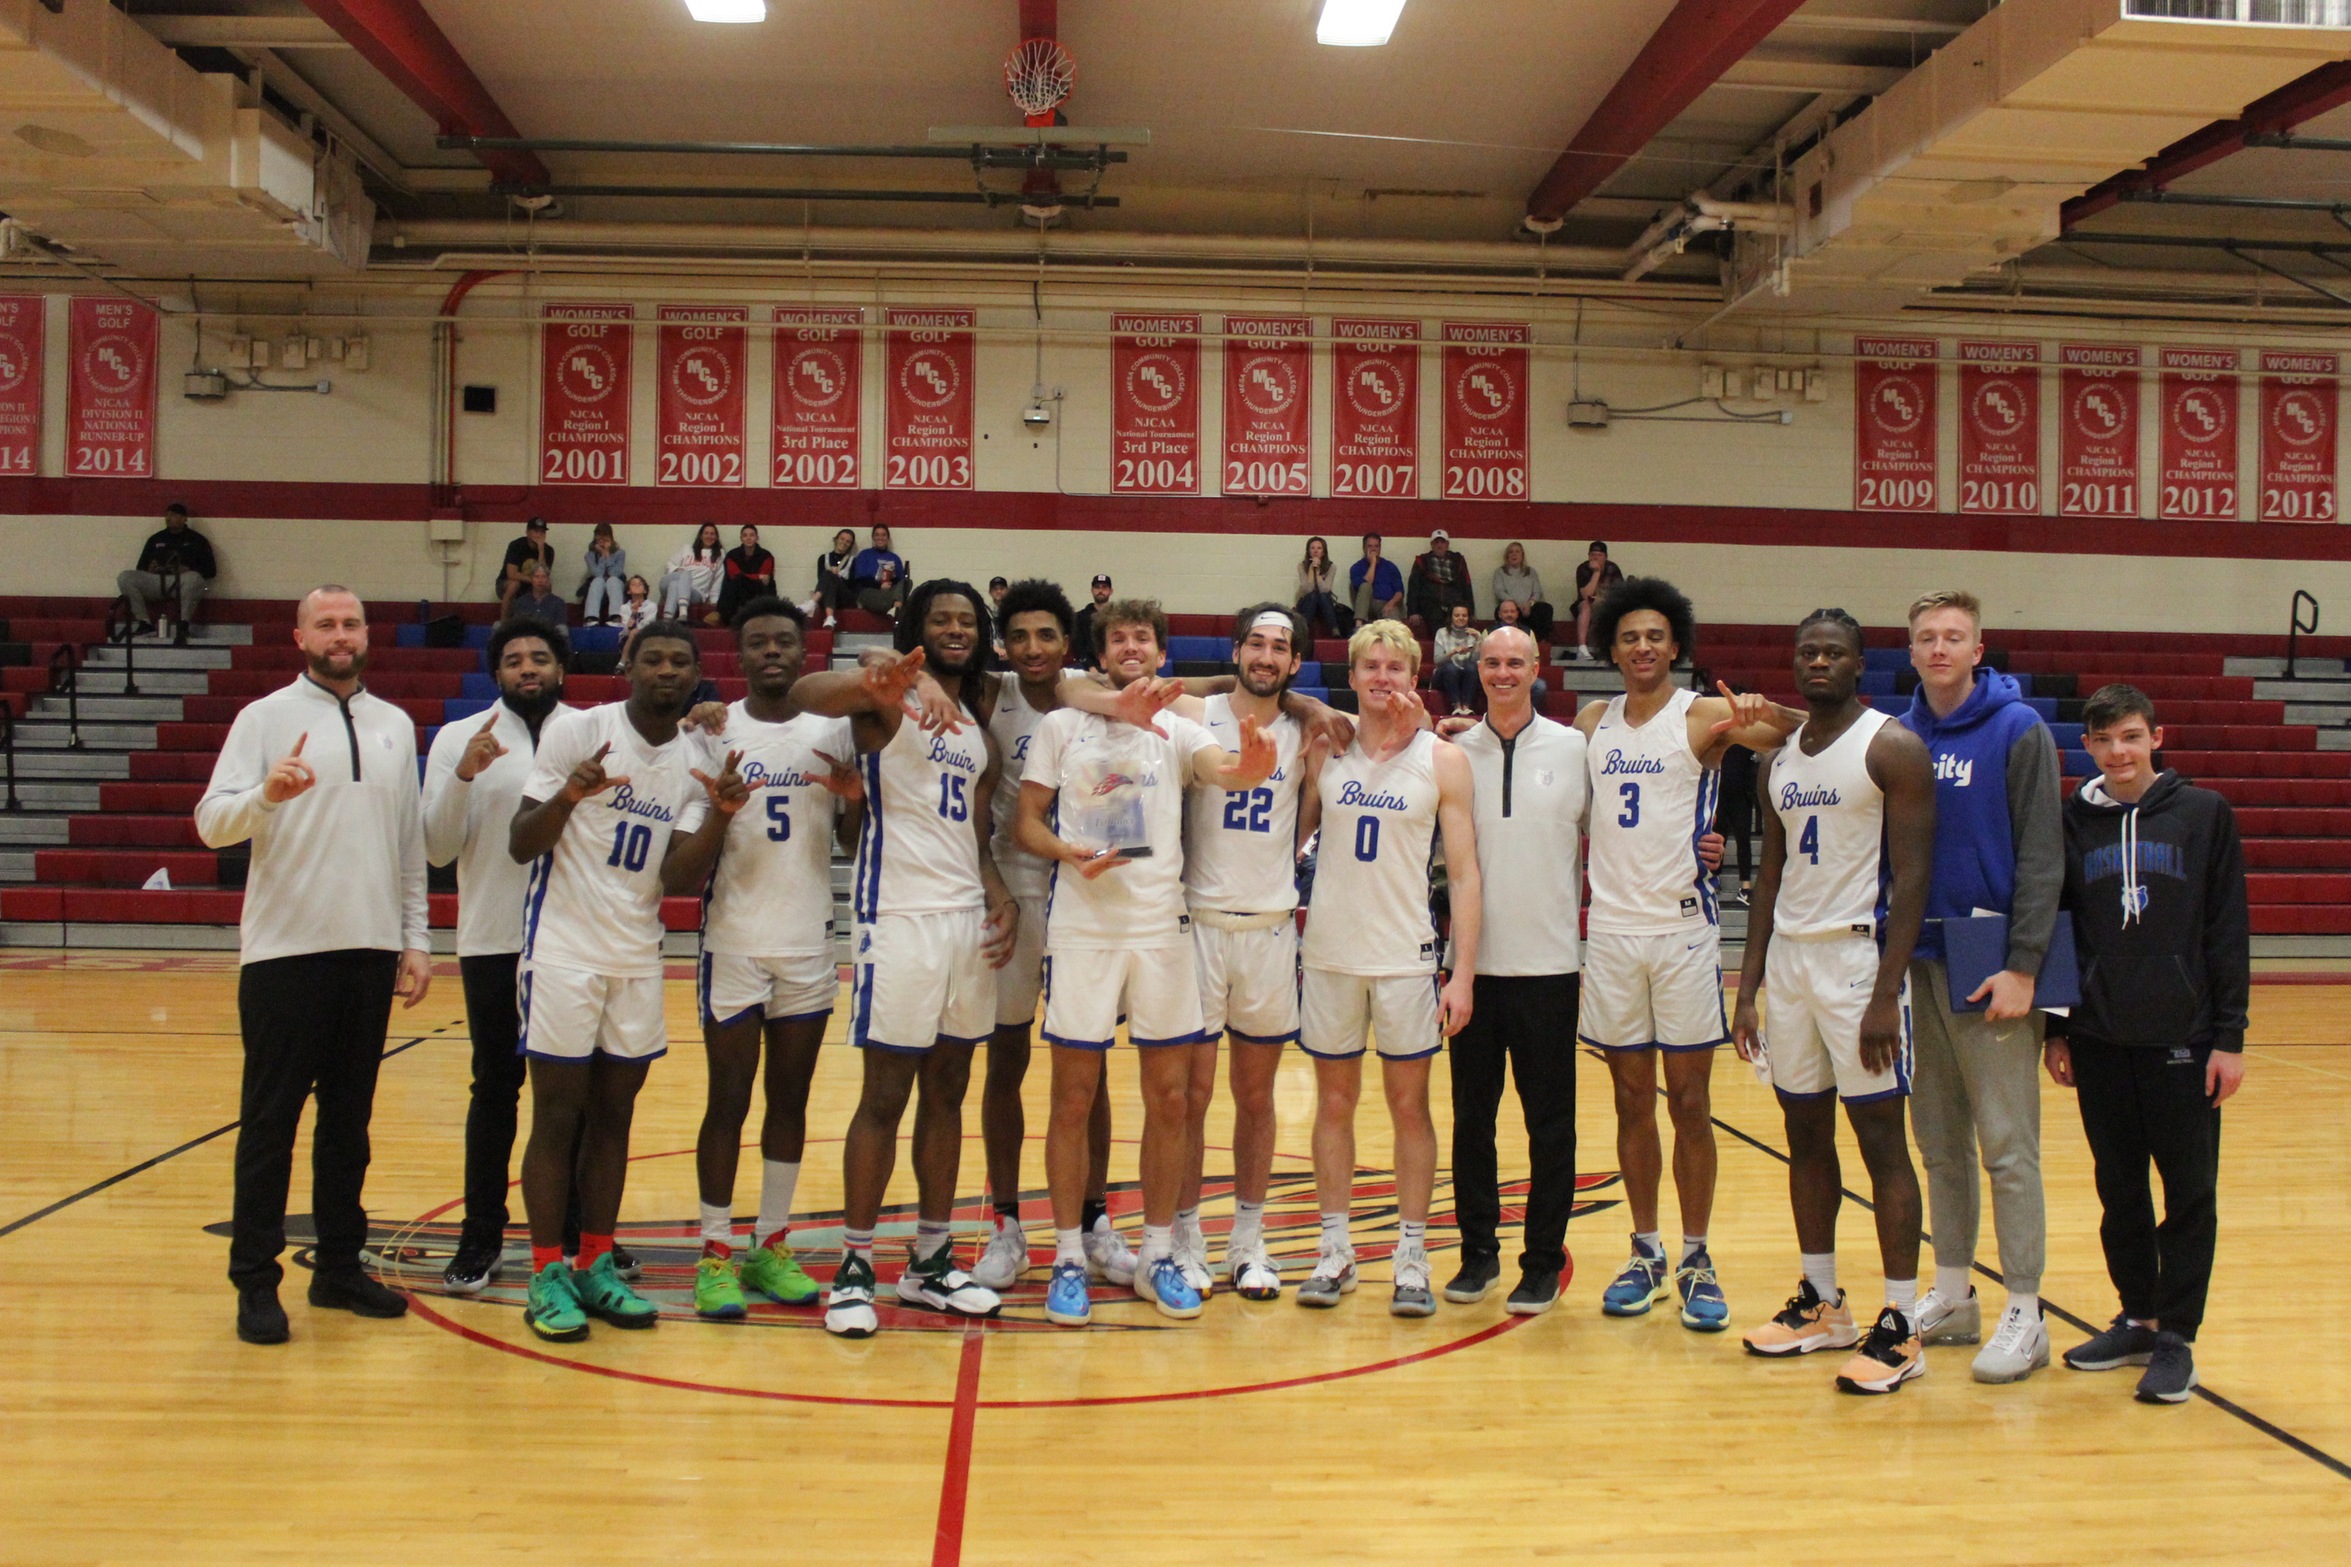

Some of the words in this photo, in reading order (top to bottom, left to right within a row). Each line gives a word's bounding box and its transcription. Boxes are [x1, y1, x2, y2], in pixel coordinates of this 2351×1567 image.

[0, 303, 19, 313] N'S
[96, 305, 132, 315] MEN'S
[551, 309, 625, 320] WOMEN'S
[666, 312, 740, 322] WOMEN'S
[780, 314, 856, 324] WOMEN'S
[98, 318, 130, 328] GOLF
[894, 315, 968, 327] WOMEN'S
[1119, 320, 1193, 332] WOMEN'S
[568, 325, 608, 337] GOLF
[682, 327, 723, 340] GOLF
[1231, 322, 1305, 335] WOMEN'S
[1339, 324, 1413, 338] WOMEN'S
[1450, 328, 1523, 341] WOMEN'S
[798, 329, 838, 341] GOLF
[911, 331, 950, 342] GOLF
[1136, 337, 1176, 348] GOLF
[1248, 341, 1288, 350] GOLF
[1356, 343, 1396, 353] GOLF
[1466, 346, 1505, 356] GOLF
[1863, 343, 1932, 356] WOMEN'S
[1965, 346, 2034, 360] WOMEN'S
[2067, 350, 2134, 364] WOMEN'S
[2167, 354, 2234, 368] WOMEN'S
[99, 348, 130, 380] MCC
[2267, 357, 2332, 371] WOMEN'S
[572, 358, 603, 389] MCC
[687, 360, 718, 392] MCC
[802, 361, 833, 393] MCC
[915, 362, 946, 394] MCC
[1141, 367, 1172, 399] MCC
[1253, 369, 1283, 401] MCC
[1362, 372, 1392, 404] MCC
[1472, 375, 1502, 407] MCC
[1883, 389, 1912, 420] MCC
[1986, 393, 2014, 423] MCC
[82, 410, 132, 418] DIVISION
[135, 410, 142, 418] II
[796, 413, 835, 422] NJCAA
[2087, 396, 2115, 427] MCC
[2186, 400, 2214, 431] MCC
[0, 414, 31, 423] EGION
[914, 415, 947, 423] NJCAA
[1135, 418, 1175, 428] NJCAA
[2286, 403, 2314, 434] MCC
[84, 421, 139, 430] NATIONAL
[564, 420, 600, 430] Region
[605, 420, 608, 429] I
[679, 422, 716, 433] Region
[721, 423, 724, 432] I
[810, 425, 855, 433] Tournament
[908, 425, 943, 436] Region
[949, 425, 953, 434] I
[1252, 422, 1284, 430] NJCAA
[1360, 424, 1393, 432] NJCAA
[1470, 427, 1503, 435] NJCAA
[80, 433, 144, 442] RUNNER-UP
[549, 433, 624, 442] CHAMPIONS
[664, 435, 740, 445] CHAMPIONS
[782, 437, 806, 448] 3rd
[812, 436, 848, 448] Place
[892, 437, 968, 447] CHAMPIONS
[1246, 432, 1282, 443] Region
[1286, 432, 1290, 441] I
[1355, 434, 1390, 445] Region
[1394, 435, 1398, 444] I
[1465, 437, 1500, 448] Region
[1505, 437, 1509, 446] I
[1122, 442, 1146, 453] 3rd
[1152, 442, 1188, 453] Place
[1230, 444, 1305, 454] CHAMPIONS
[1339, 446, 1413, 456] CHAMPIONS
[2085, 446, 2116, 454] NJCAA
[0, 447, 30, 469] 14
[76, 448, 145, 471] 2014
[1450, 449, 1523, 459] CHAMPIONS
[1877, 449, 1912, 460] Region
[1980, 453, 2014, 463] Region
[2080, 454, 2114, 465] Region
[2185, 450, 2215, 458] NJCAA
[2285, 452, 2316, 461] NJCAA
[545, 449, 624, 479] 2001
[660, 453, 740, 482] 2002
[776, 454, 855, 484] 2002
[1863, 461, 1932, 471] CHAMPIONS
[1966, 465, 2035, 474] CHAMPIONS
[2180, 458, 2214, 469] Region
[2280, 461, 2313, 472] Region
[888, 455, 969, 485] 2003
[1117, 460, 1193, 487] 2004
[1227, 462, 1307, 490] 2005
[2067, 467, 2134, 477] CHAMPIONS
[2166, 470, 2234, 481] CHAMPIONS
[1335, 464, 1413, 494] 2007
[1447, 466, 1524, 495] 2008
[2267, 474, 2331, 483] CHAMPIONS
[1860, 478, 1933, 507] 2009
[1963, 480, 2036, 510] 2010
[2064, 483, 2133, 514] 2011
[2164, 486, 2234, 516] 2012
[2264, 490, 2333, 520] 2013
[1601, 748, 1664, 775] Bruins
[1933, 753, 1973, 786] ity
[938, 773, 967, 822] 15
[1337, 780, 1407, 811] Bruins
[1780, 782, 1841, 812] Bruins
[607, 784, 673, 822] Bruins
[1618, 782, 1640, 828] 3
[1223, 787, 1273, 833] 22
[766, 796, 790, 842] 5
[1355, 815, 1380, 862] 0
[1800, 815, 1818, 865] 4
[607, 821, 652, 872] 10
